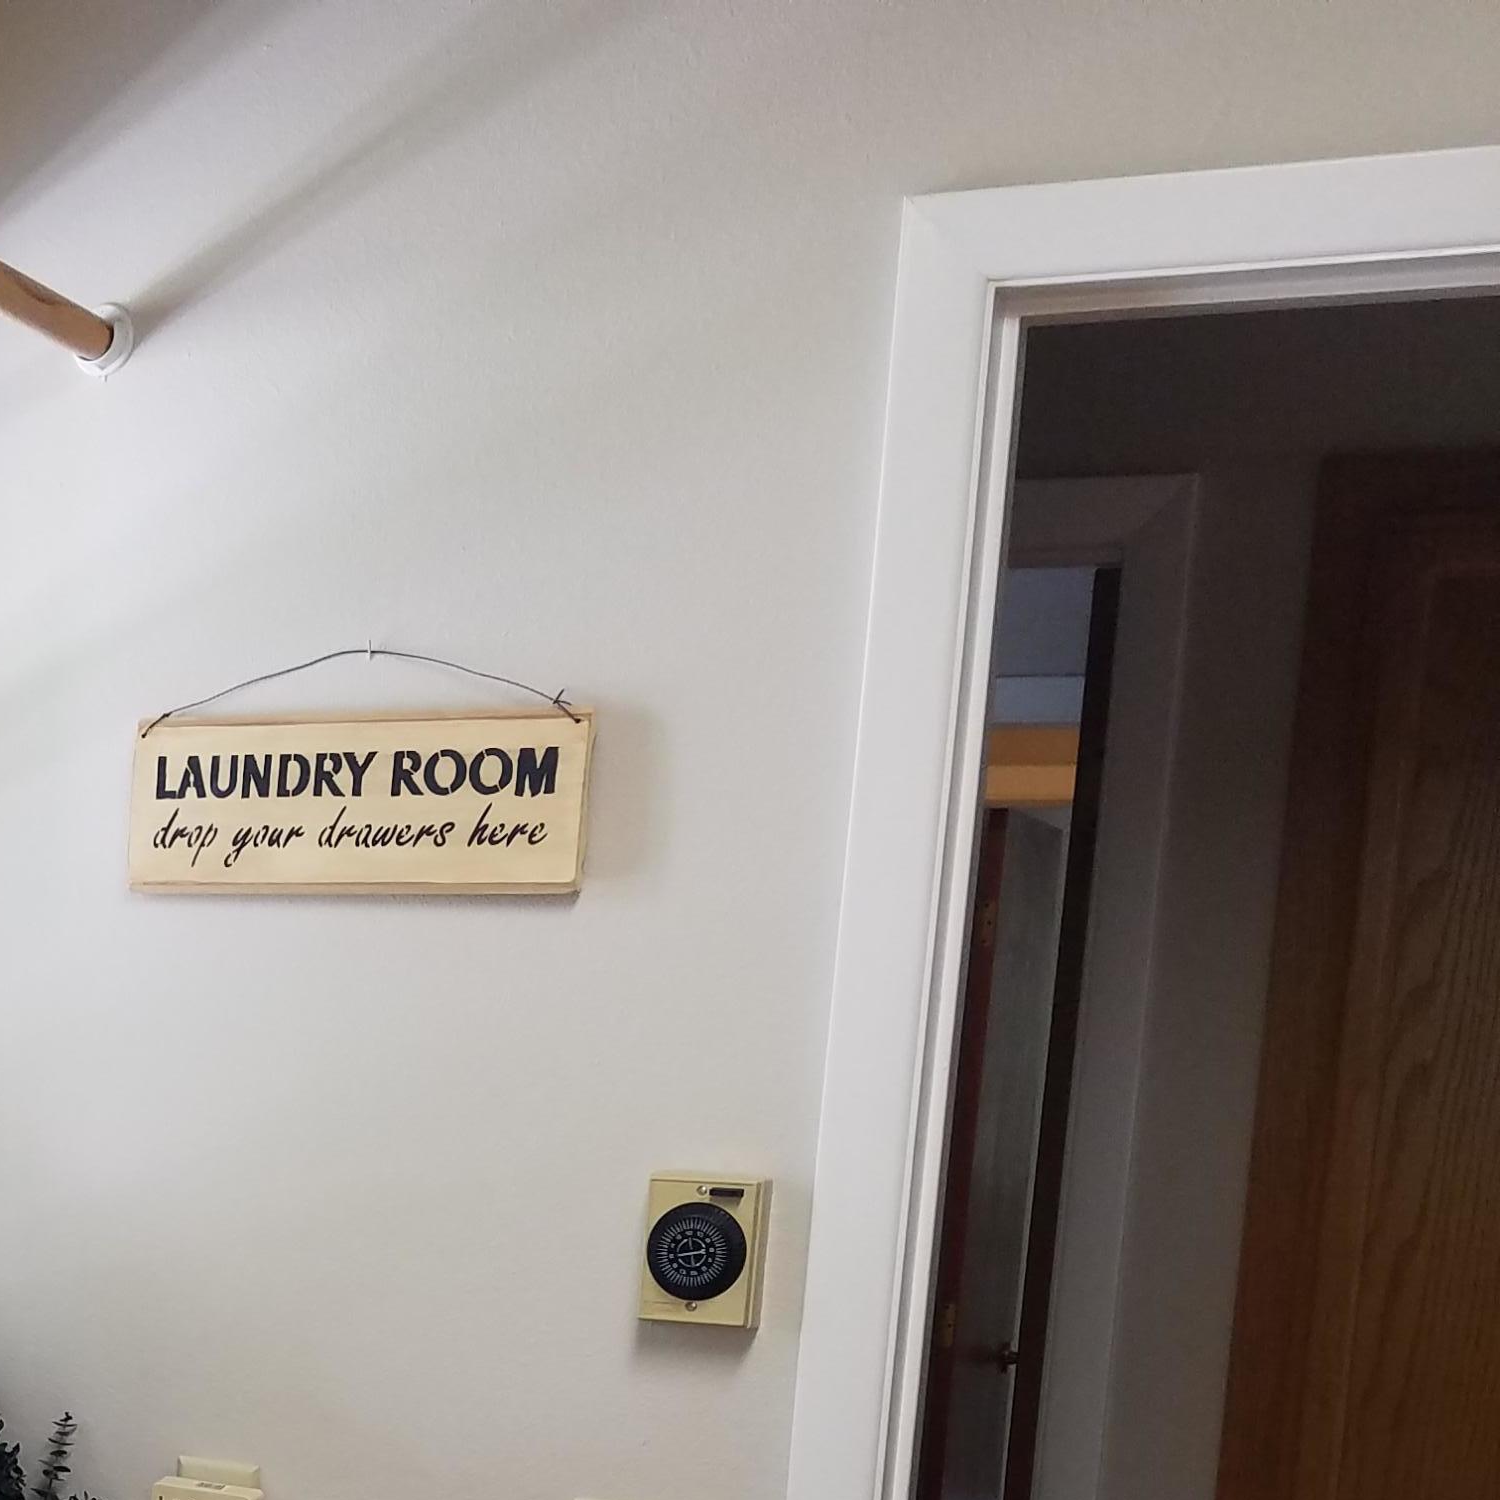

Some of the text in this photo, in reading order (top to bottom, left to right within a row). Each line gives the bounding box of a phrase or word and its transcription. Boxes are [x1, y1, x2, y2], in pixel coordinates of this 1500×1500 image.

[155, 746, 560, 800] LAUNDRY ROOM
[153, 803, 548, 868] drop your drawers here
